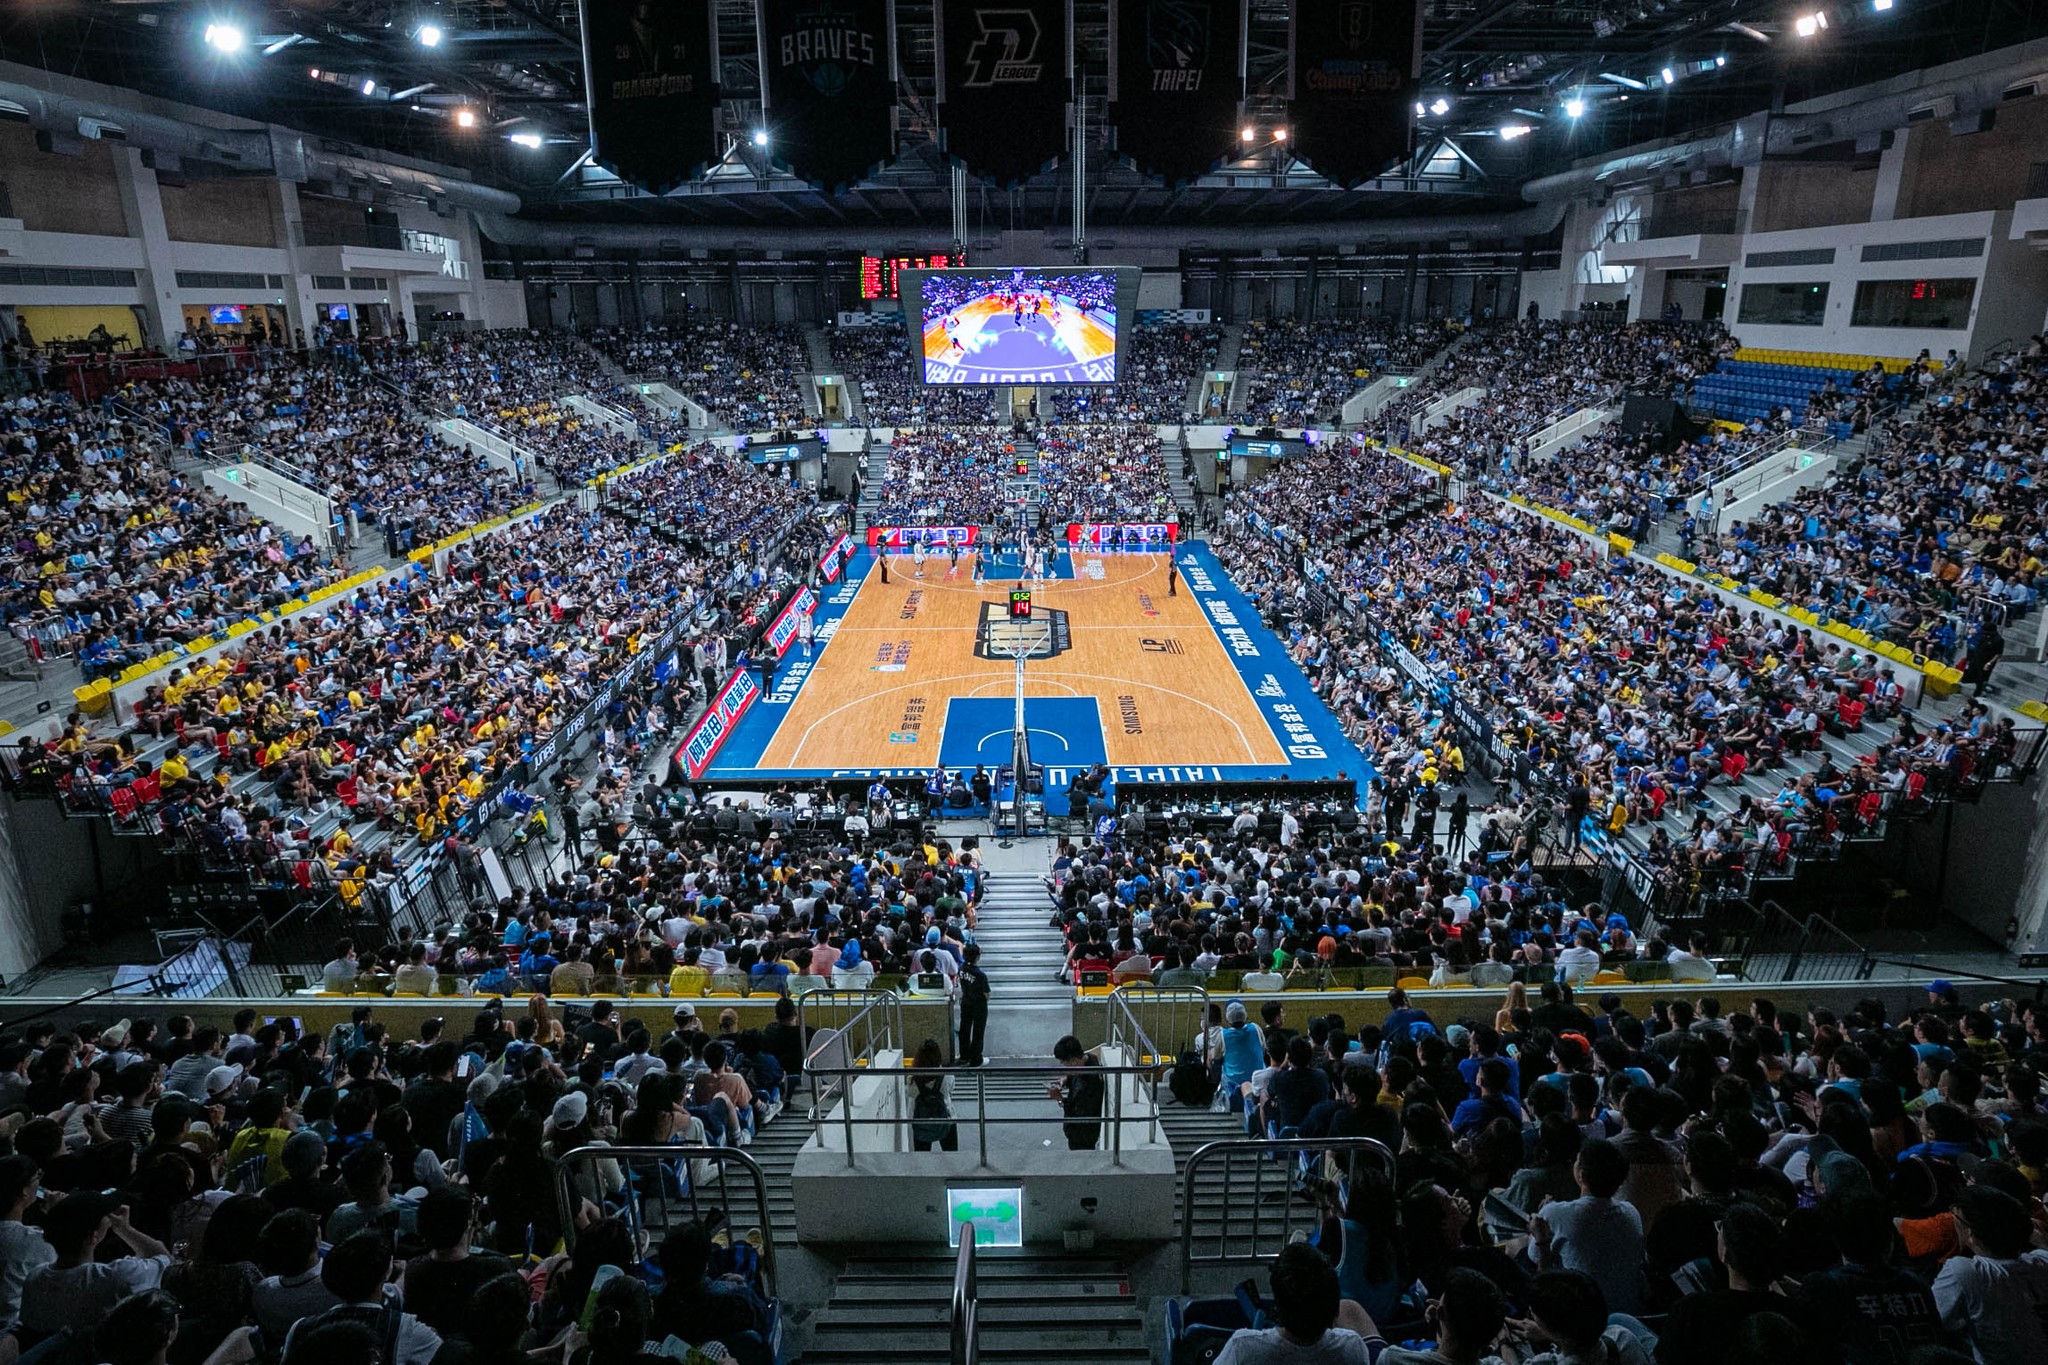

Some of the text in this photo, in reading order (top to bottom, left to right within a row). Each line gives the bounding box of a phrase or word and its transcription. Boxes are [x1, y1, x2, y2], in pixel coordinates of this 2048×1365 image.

[781, 28, 875, 66] BRAVES
[994, 66, 1039, 80] LEAGUE
[1152, 67, 1204, 91] TAIPEI
[1014, 602, 1030, 614] 14
[1142, 639, 1167, 652] LP
[723, 673, 754, 716] 阿華田
[1117, 695, 1143, 735] SAMSUNG
[1273, 704, 1318, 743] 富邦金控
[688, 713, 723, 766] 阿華田
[1491, 733, 1518, 772] BRAVES
